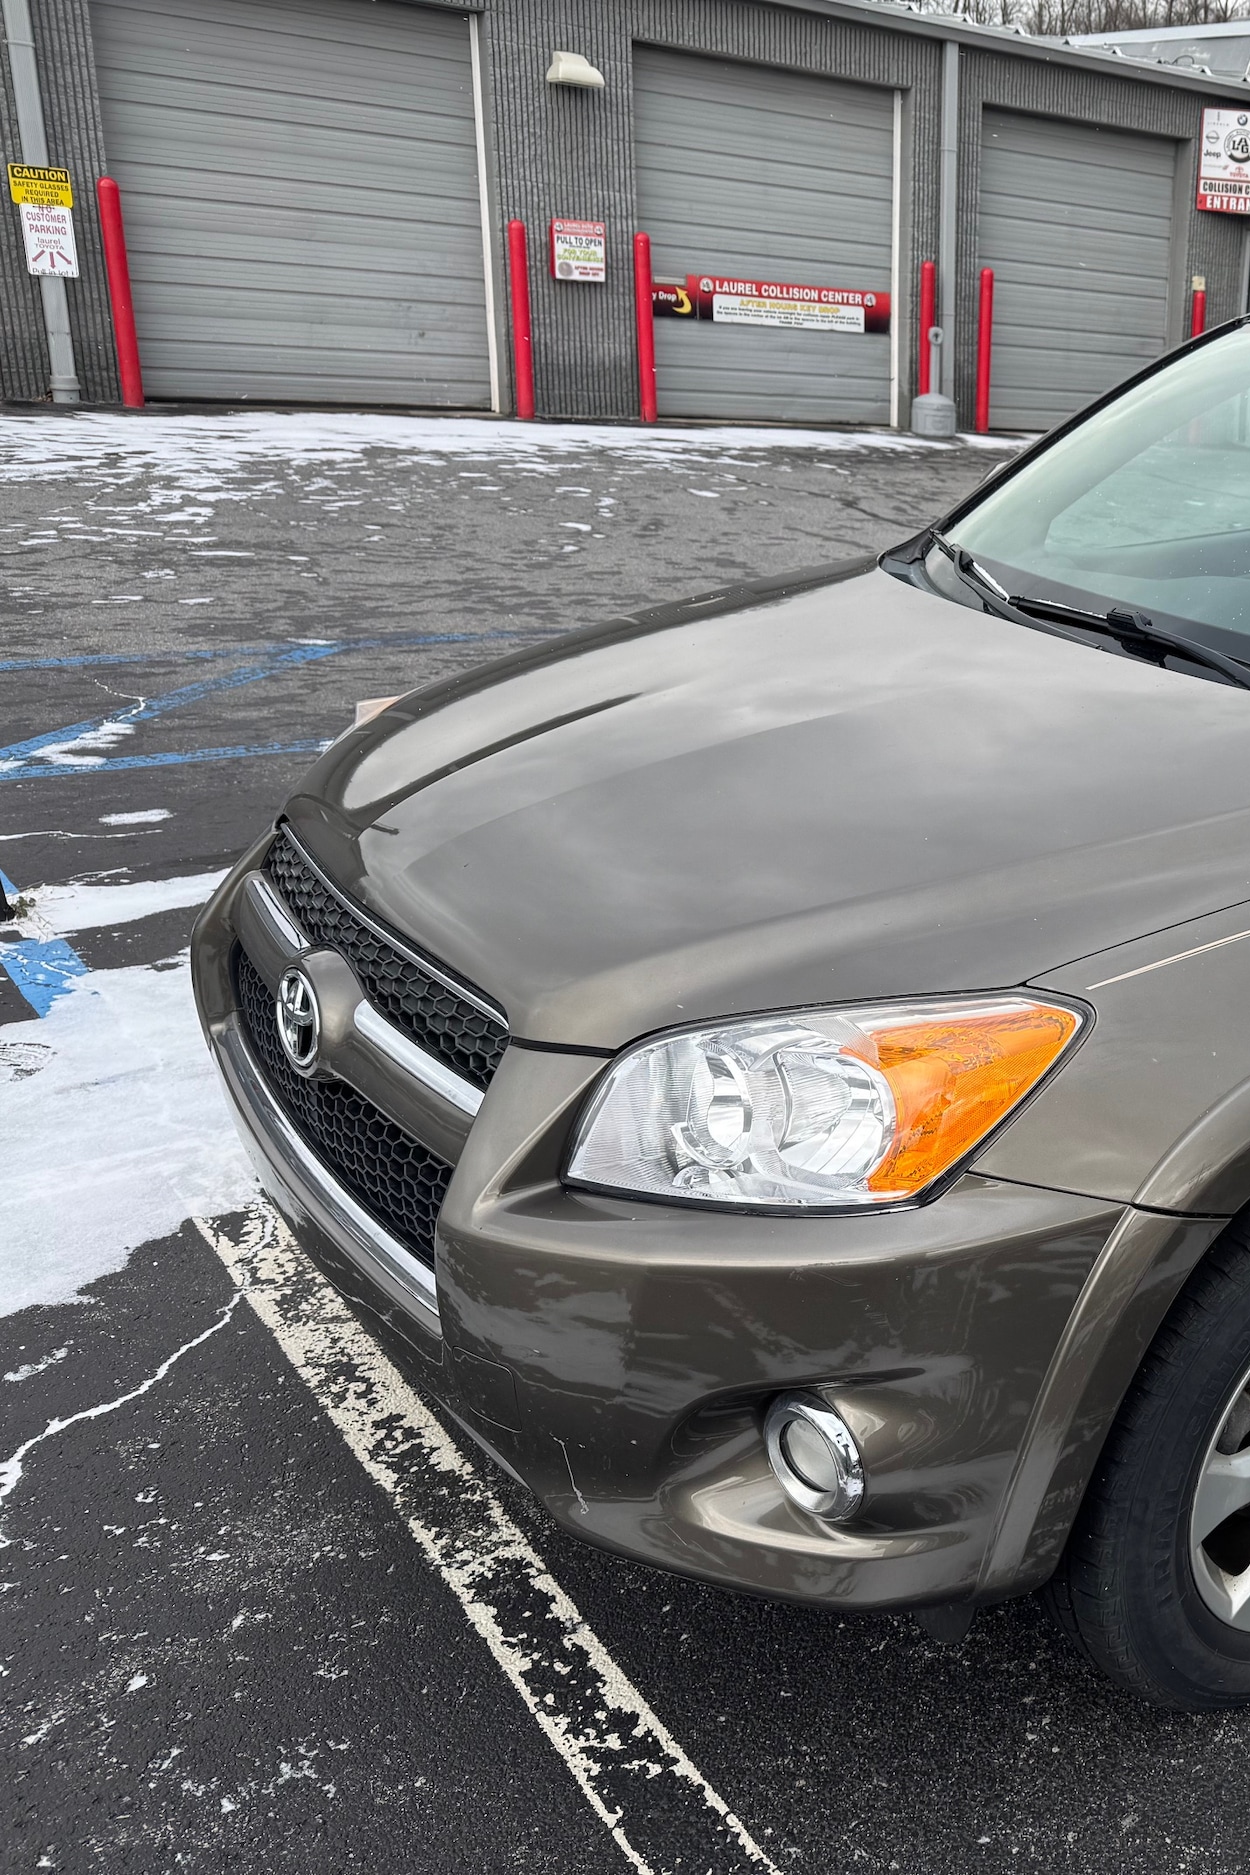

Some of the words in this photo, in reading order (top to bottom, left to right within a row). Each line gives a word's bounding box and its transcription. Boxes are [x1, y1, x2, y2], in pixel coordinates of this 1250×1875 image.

[1203, 149, 1221, 158] Jeep
[13, 167, 66, 182] CAUTION
[13, 180, 38, 189] SAFETY
[39, 183, 69, 192] GLASSES
[1203, 181, 1243, 195] COLLISION
[25, 189, 59, 198] REQUIRED
[30, 196, 45, 204] THIS
[46, 198, 65, 206] AREA
[26, 211, 67, 224] CUSTOMER
[29, 224, 67, 236] PARKING
[37, 237, 61, 245] laurel
[556, 235, 573, 245] PULL
[574, 237, 583, 246] TO
[585, 238, 603, 247] OPEN
[658, 291, 677, 302] Drop
[715, 281, 759, 296] LAUREL
[761, 285, 819, 301] COLLISION
[821, 290, 862, 305] CENTER
[740, 299, 767, 309] AFTER
[769, 301, 798, 311] HOURS
[800, 304, 817, 313] KEY
